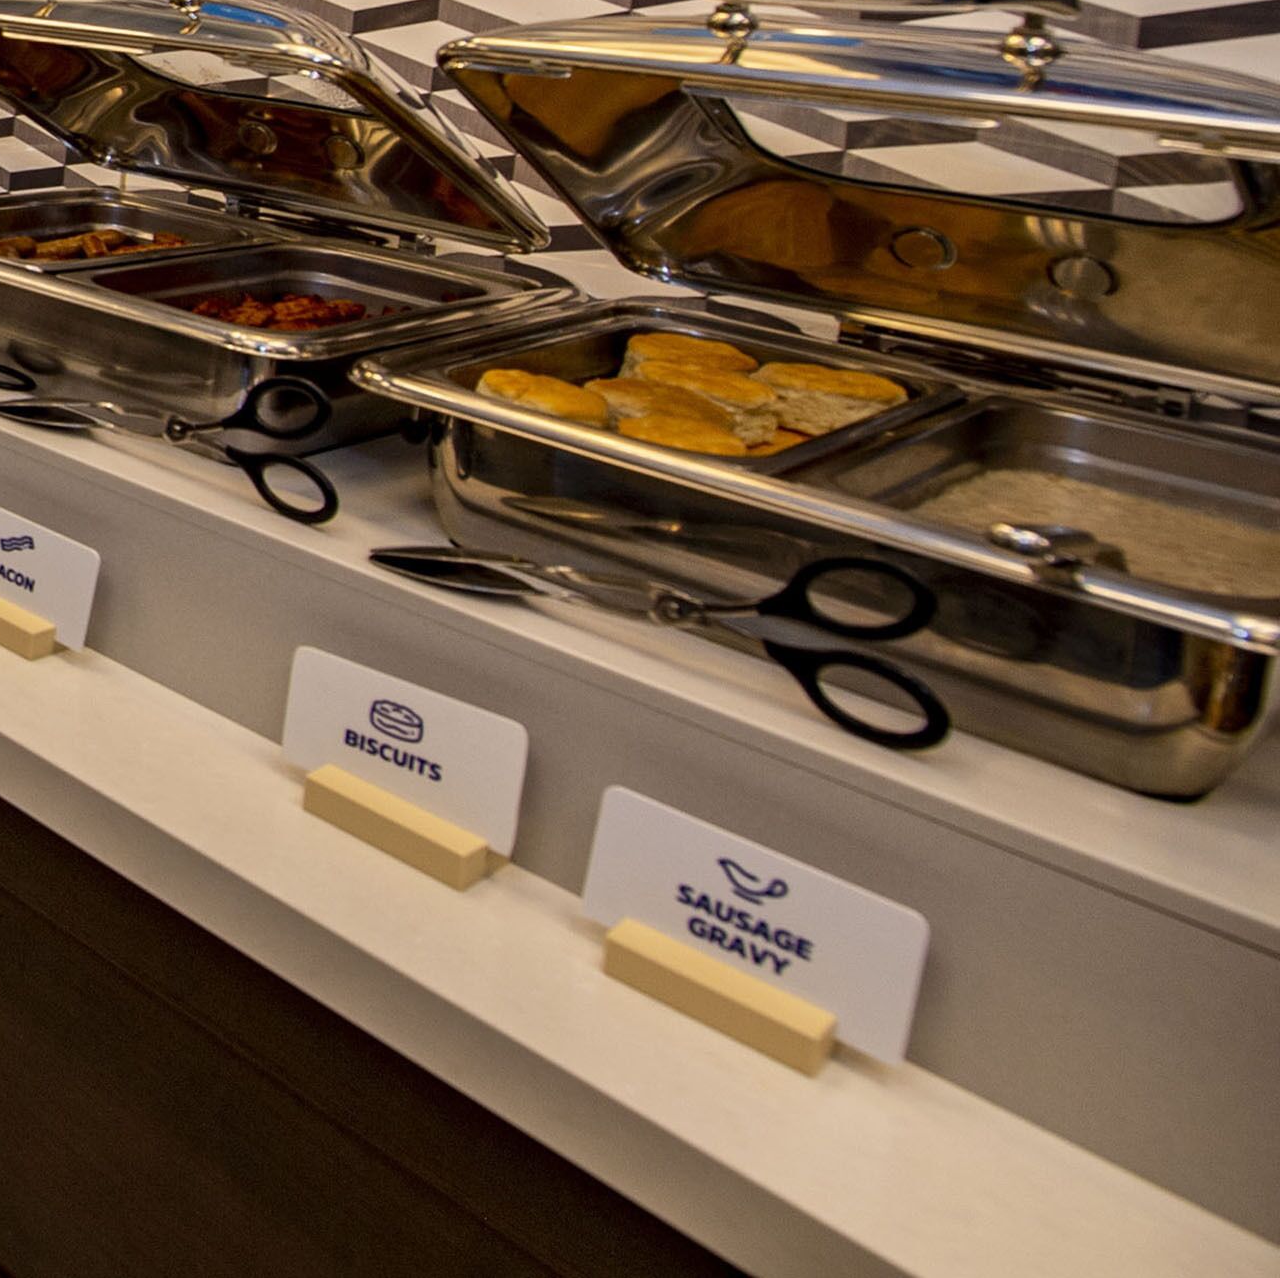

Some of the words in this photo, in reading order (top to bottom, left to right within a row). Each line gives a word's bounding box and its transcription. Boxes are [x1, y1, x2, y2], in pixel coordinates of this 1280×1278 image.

[344, 728, 443, 782] BISCUITS
[676, 883, 814, 961] SAUSAGE
[687, 916, 792, 977] GRAVY
